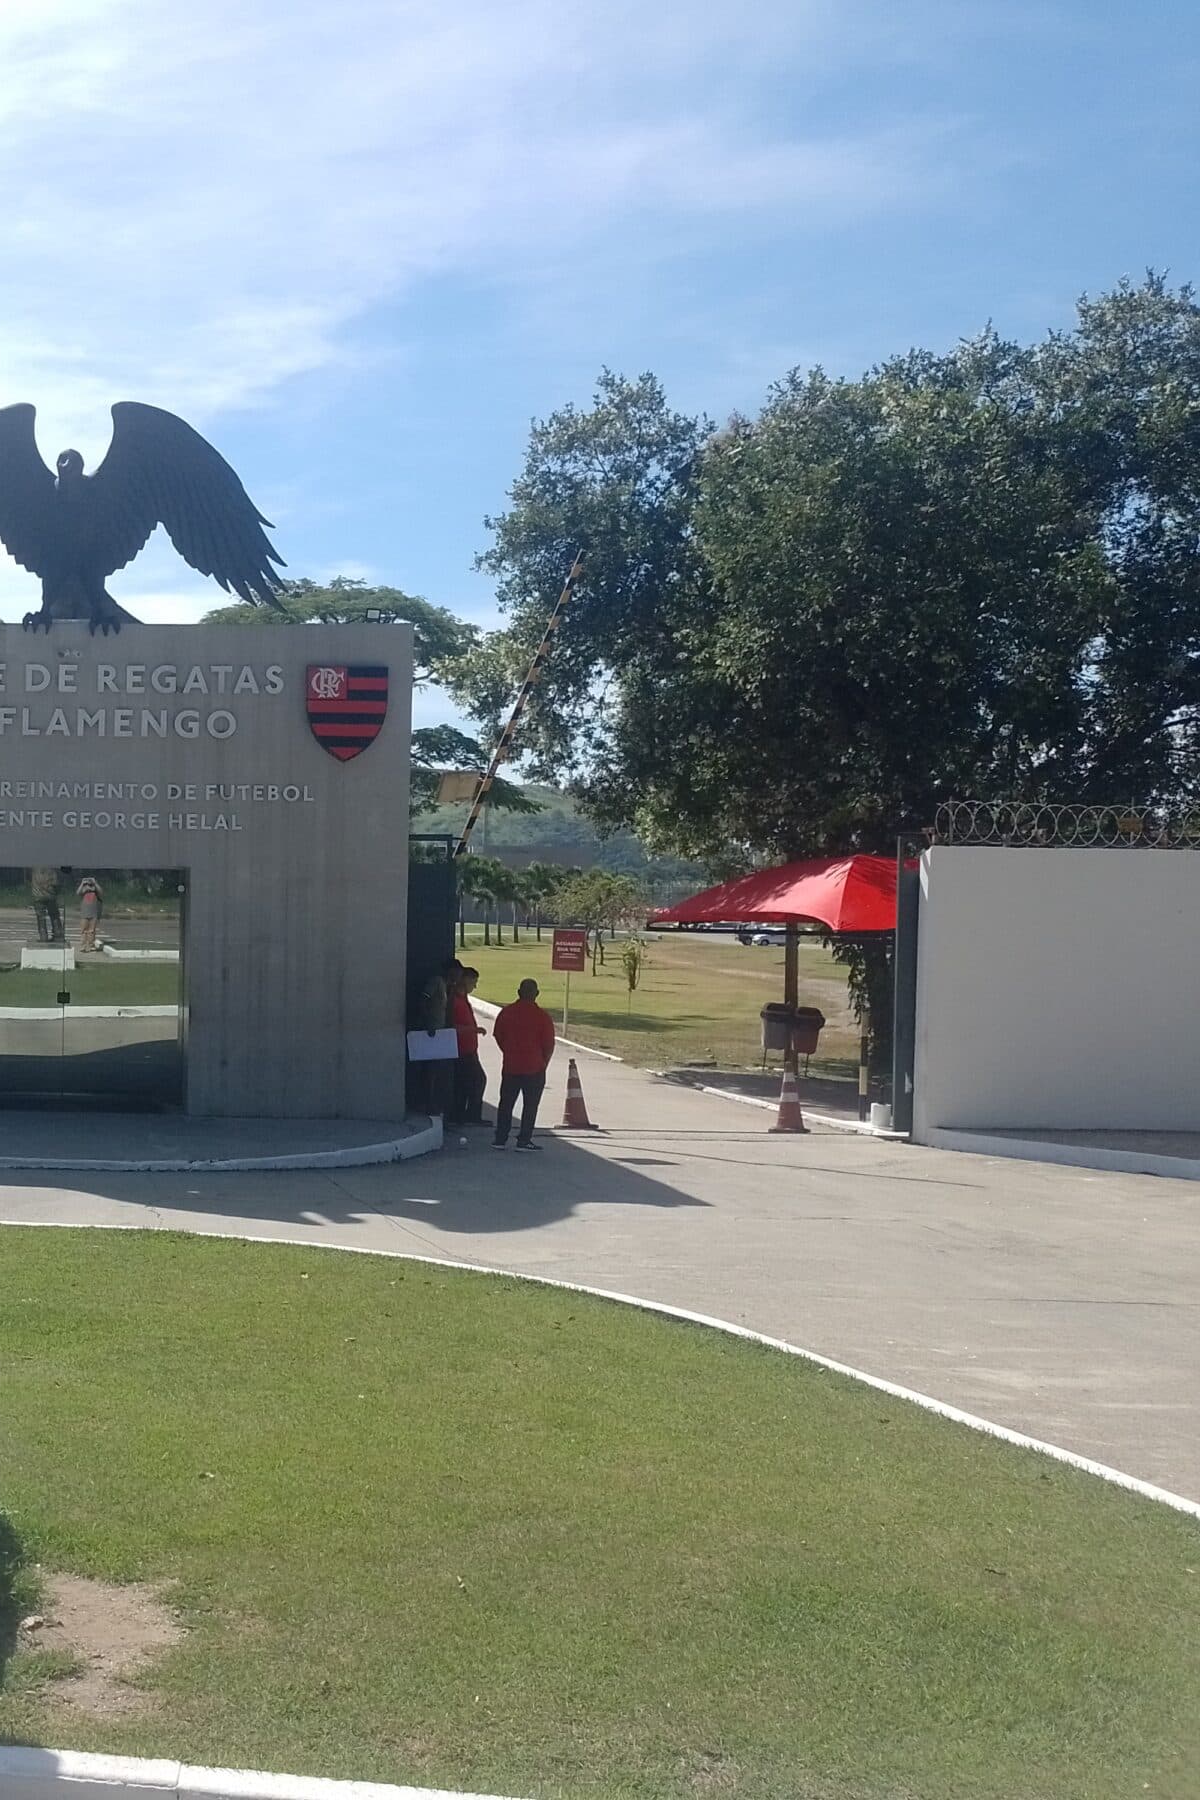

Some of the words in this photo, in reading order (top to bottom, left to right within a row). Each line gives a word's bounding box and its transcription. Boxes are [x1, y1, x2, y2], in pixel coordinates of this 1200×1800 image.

[24, 663, 79, 692] DE
[97, 664, 285, 694] REGATAS
[167, 784, 197, 800] DE
[205, 784, 315, 802] FUTEBOL
[62, 811, 160, 829] GEORGE
[168, 813, 243, 831] HELAL
